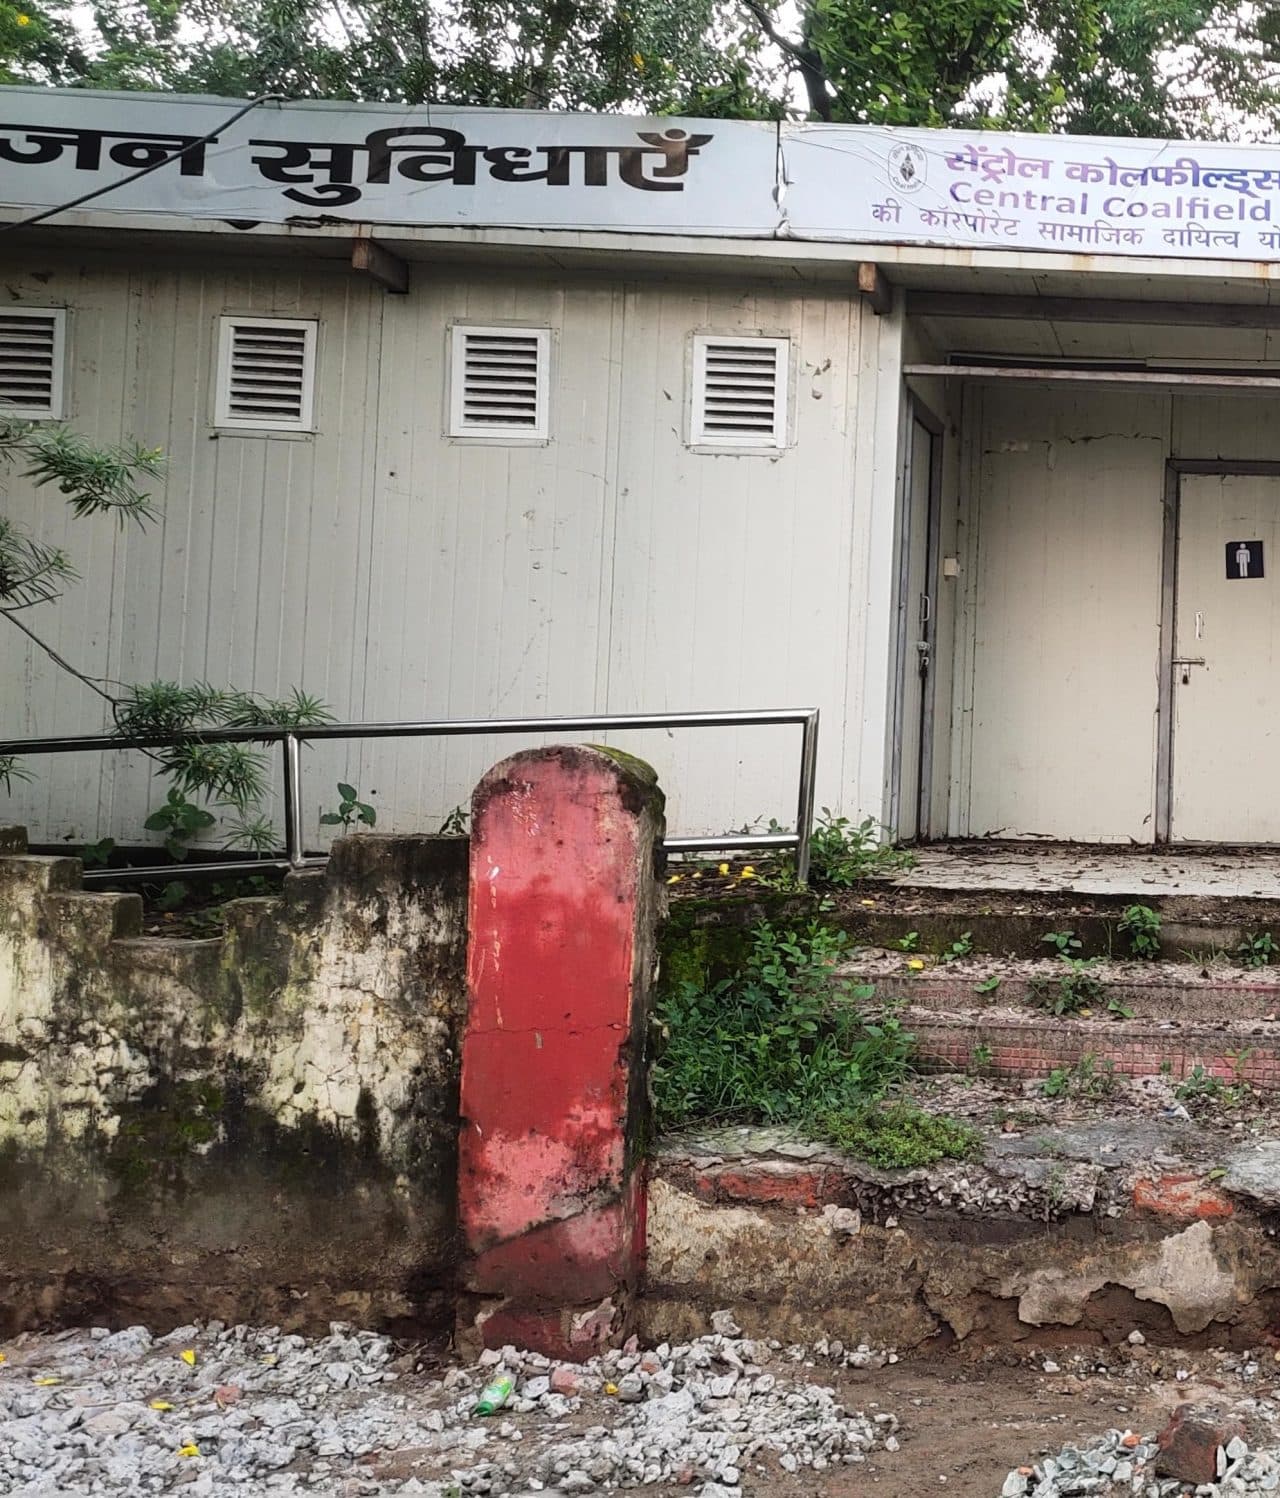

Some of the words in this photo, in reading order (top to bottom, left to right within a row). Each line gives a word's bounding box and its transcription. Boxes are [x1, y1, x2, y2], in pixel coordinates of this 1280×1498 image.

[0, 123, 218, 177] जन
[248, 126, 714, 208] सुविधाएँ
[943, 143, 1054, 185] सेंट्रोल
[872, 197, 902, 223] की
[1037, 219, 1145, 245] सामाजिक
[1162, 221, 1240, 248] दायित्व
[949, 181, 1088, 216] Central
[1102, 195, 1272, 222] Coalfield
